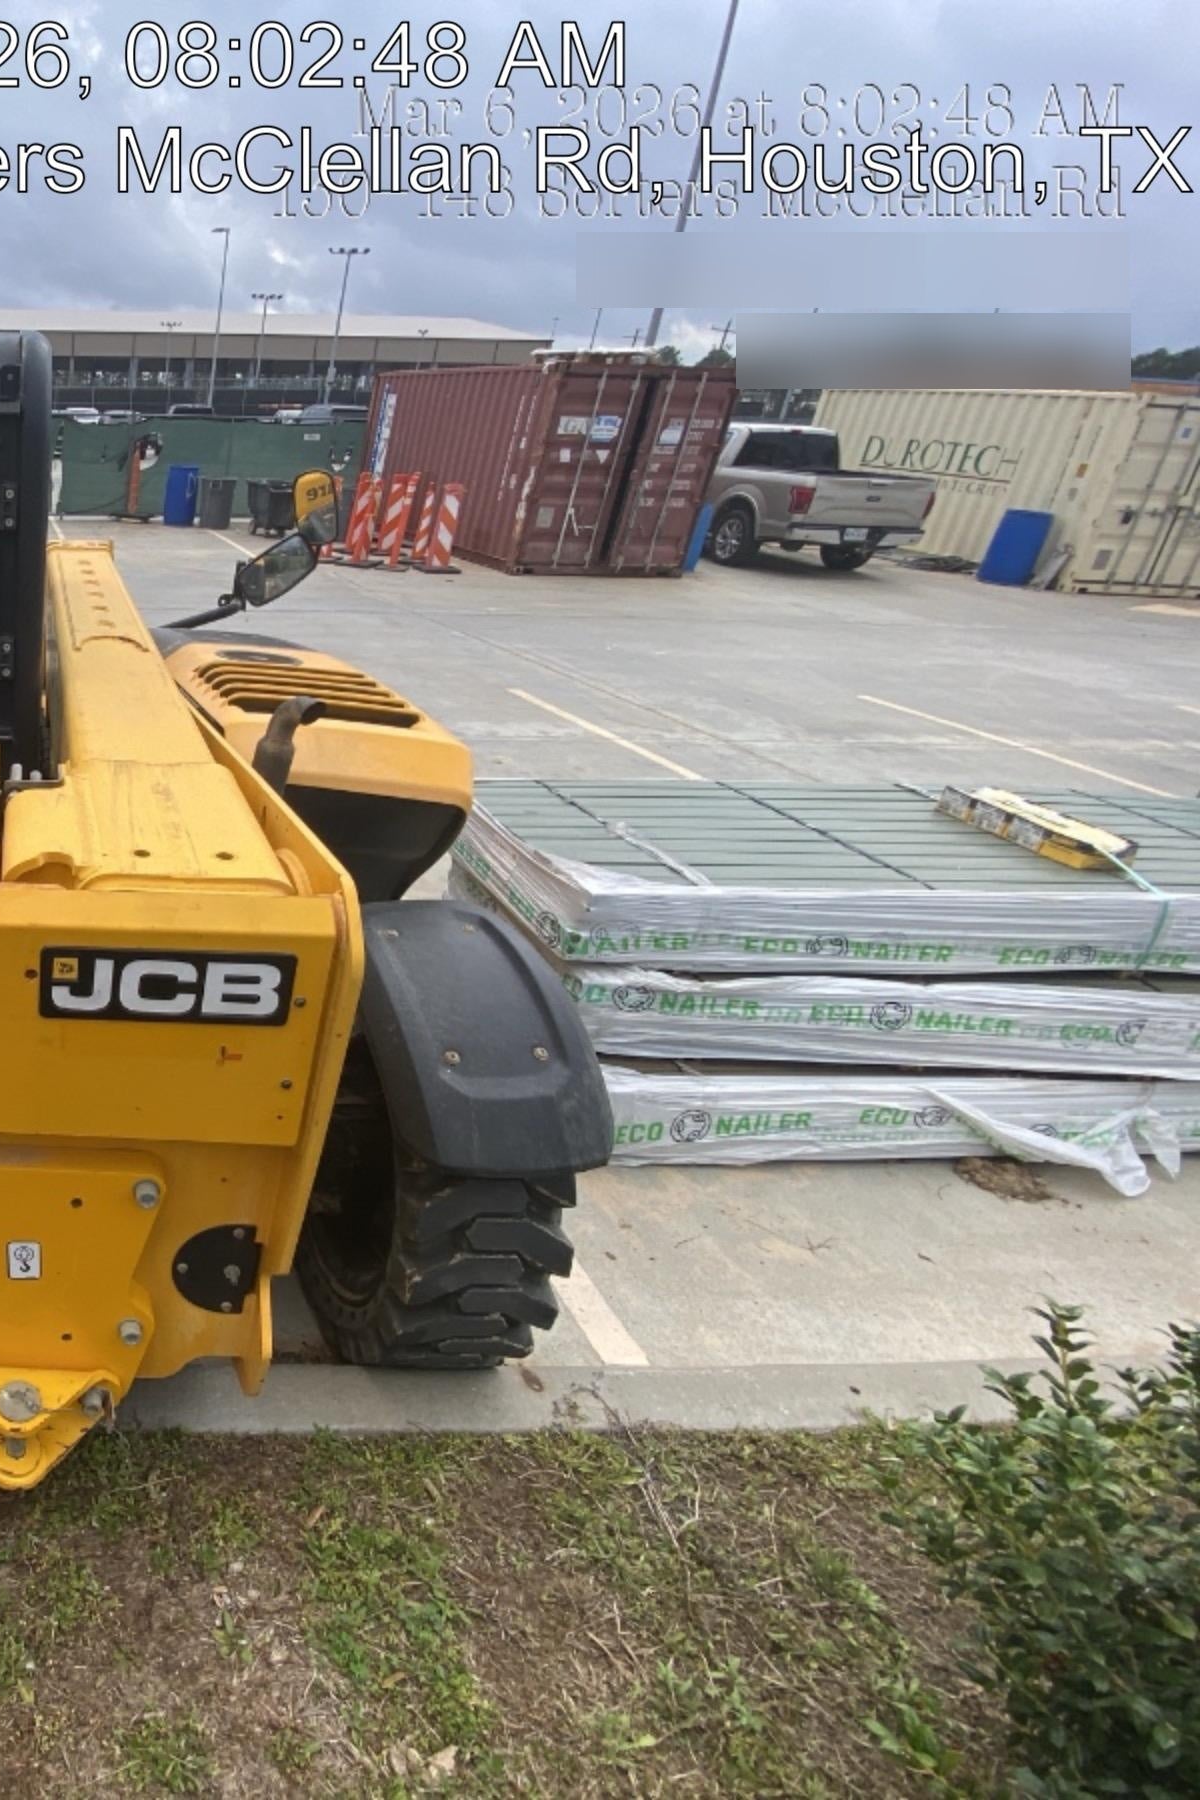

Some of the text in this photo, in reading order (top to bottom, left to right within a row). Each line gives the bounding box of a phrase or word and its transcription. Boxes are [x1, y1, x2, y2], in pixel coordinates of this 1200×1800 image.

[744, 935, 800, 954] ECO
[997, 947, 1050, 965] ECO
[51, 958, 282, 1017] JCB
[658, 992, 761, 1020] NAILER
[915, 1009, 1016, 1036] NAILER
[615, 1121, 665, 1145] ECO
[715, 1111, 813, 1137] NAILER
